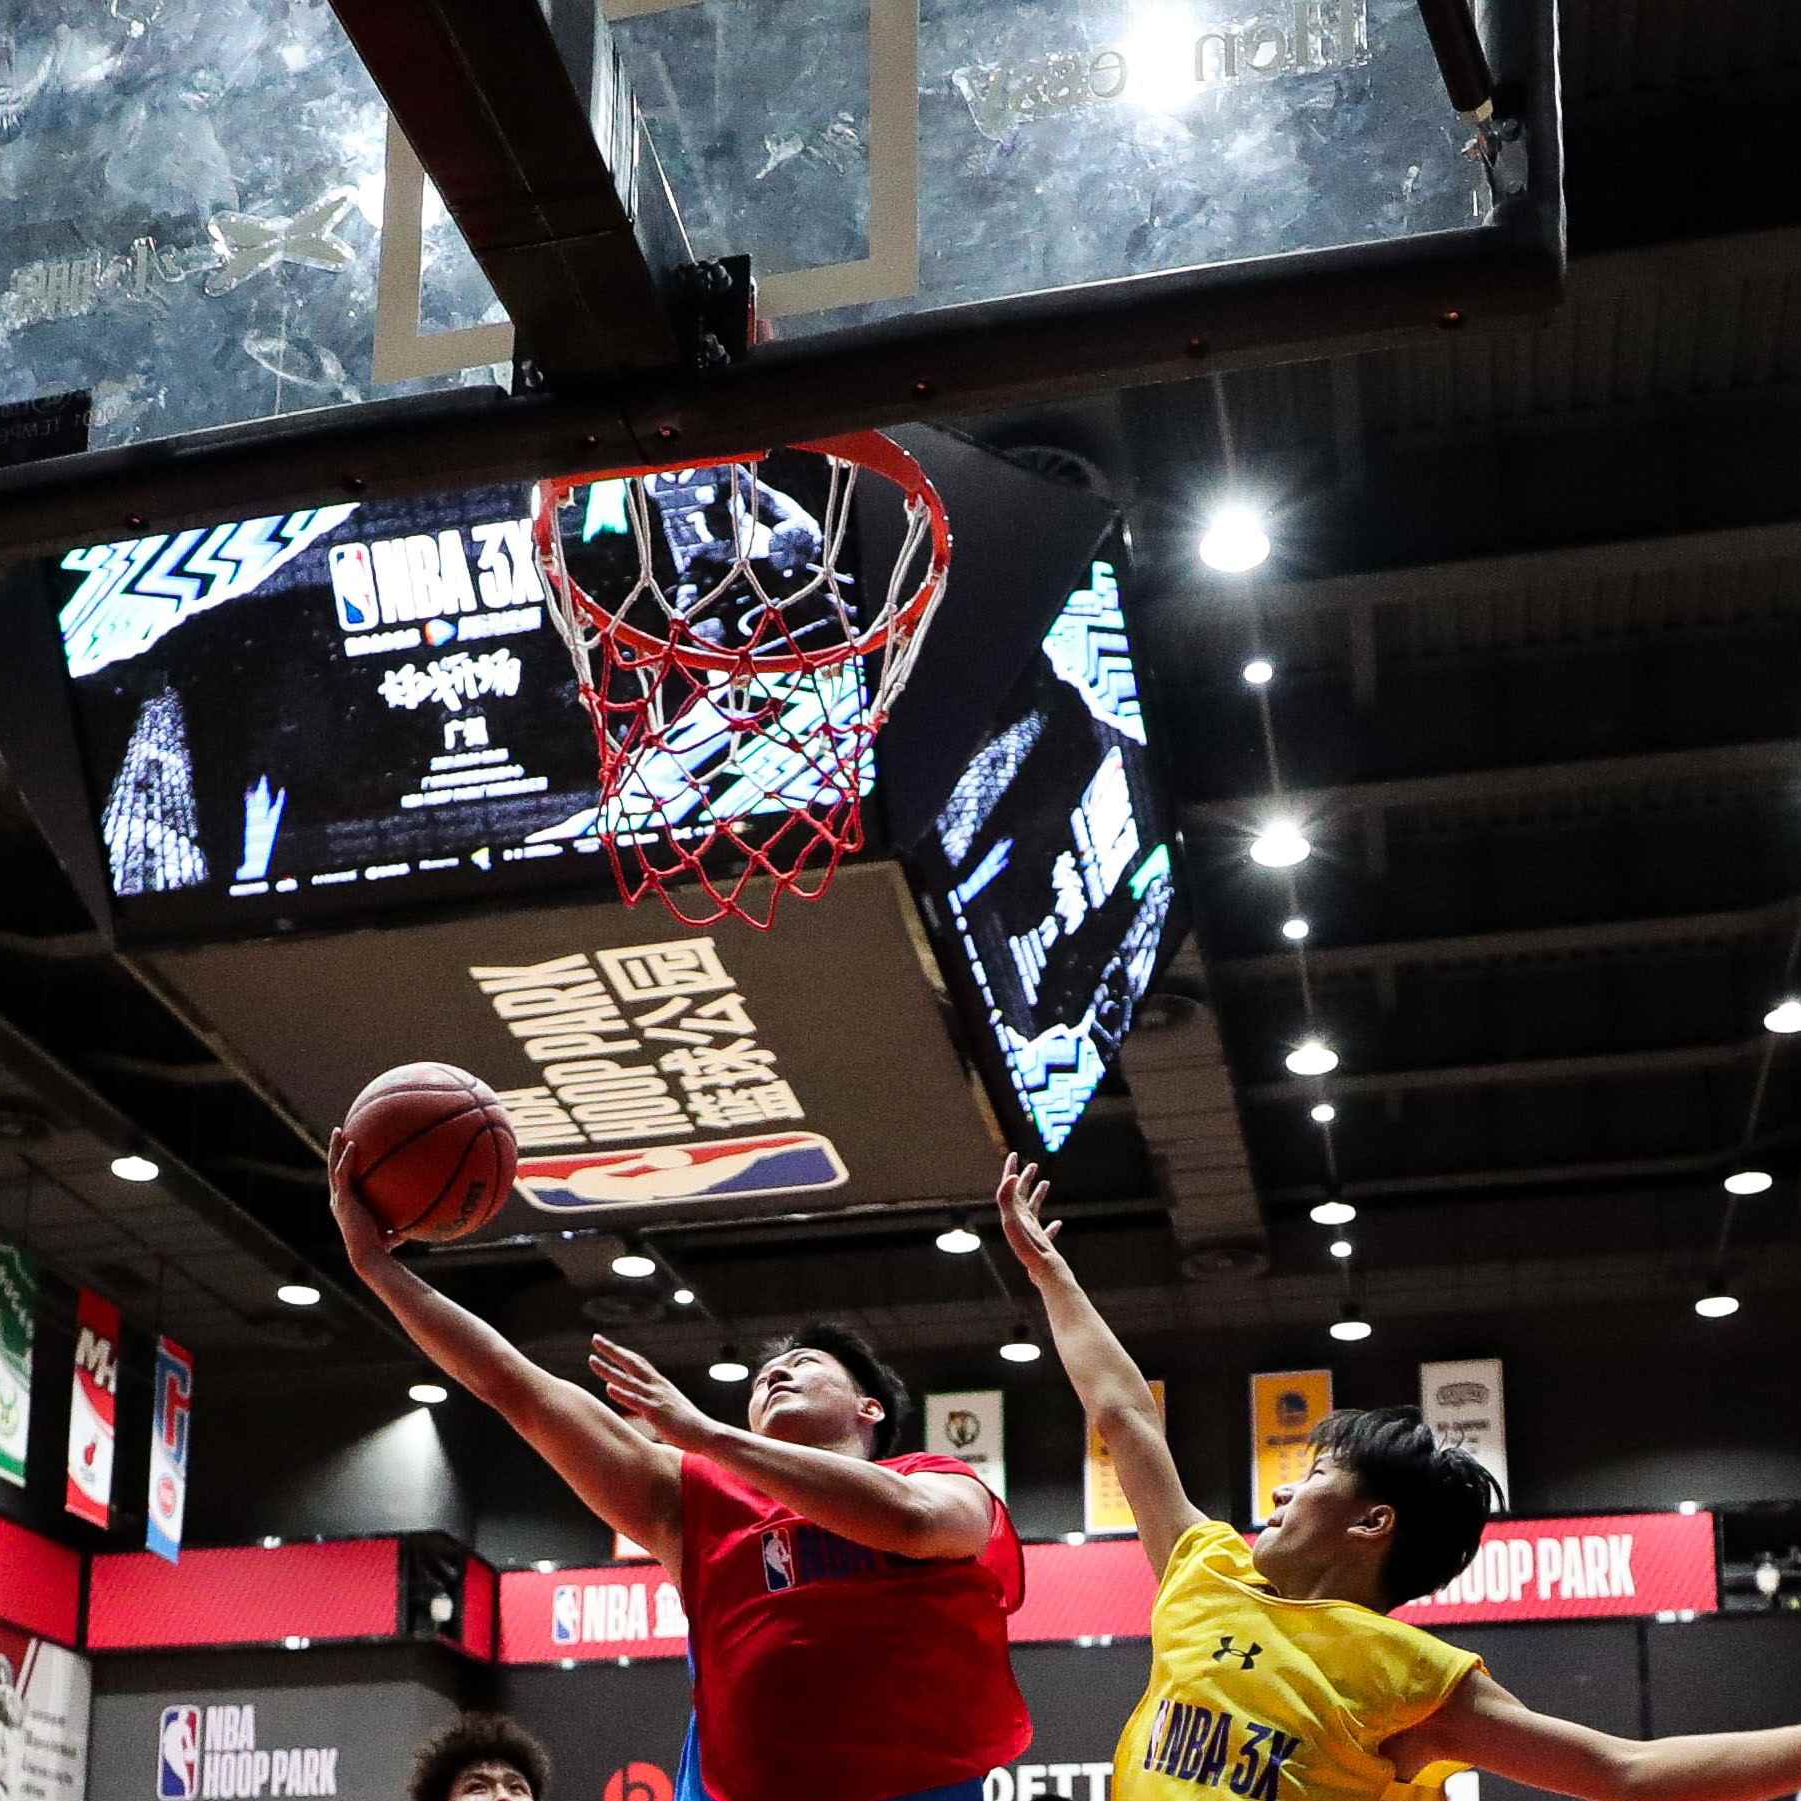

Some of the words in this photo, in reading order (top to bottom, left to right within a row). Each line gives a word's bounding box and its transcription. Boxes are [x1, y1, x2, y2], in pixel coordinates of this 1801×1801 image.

[370, 529, 478, 624] NBA
[471, 518, 546, 608] 3X
[469, 953, 641, 1063] PARK
[596, 936, 805, 1130] 篮球公园
[497, 1086, 589, 1149] NBA
[543, 1058, 695, 1143] HOOP
[1538, 1534, 1634, 1600] PARK
[581, 1584, 649, 1643] NBA
[204, 1703, 255, 1751] NBA
[1163, 1700, 1235, 1788] NBA
[202, 1749, 270, 1800] HOOP
[271, 1748, 338, 1798] PARK
